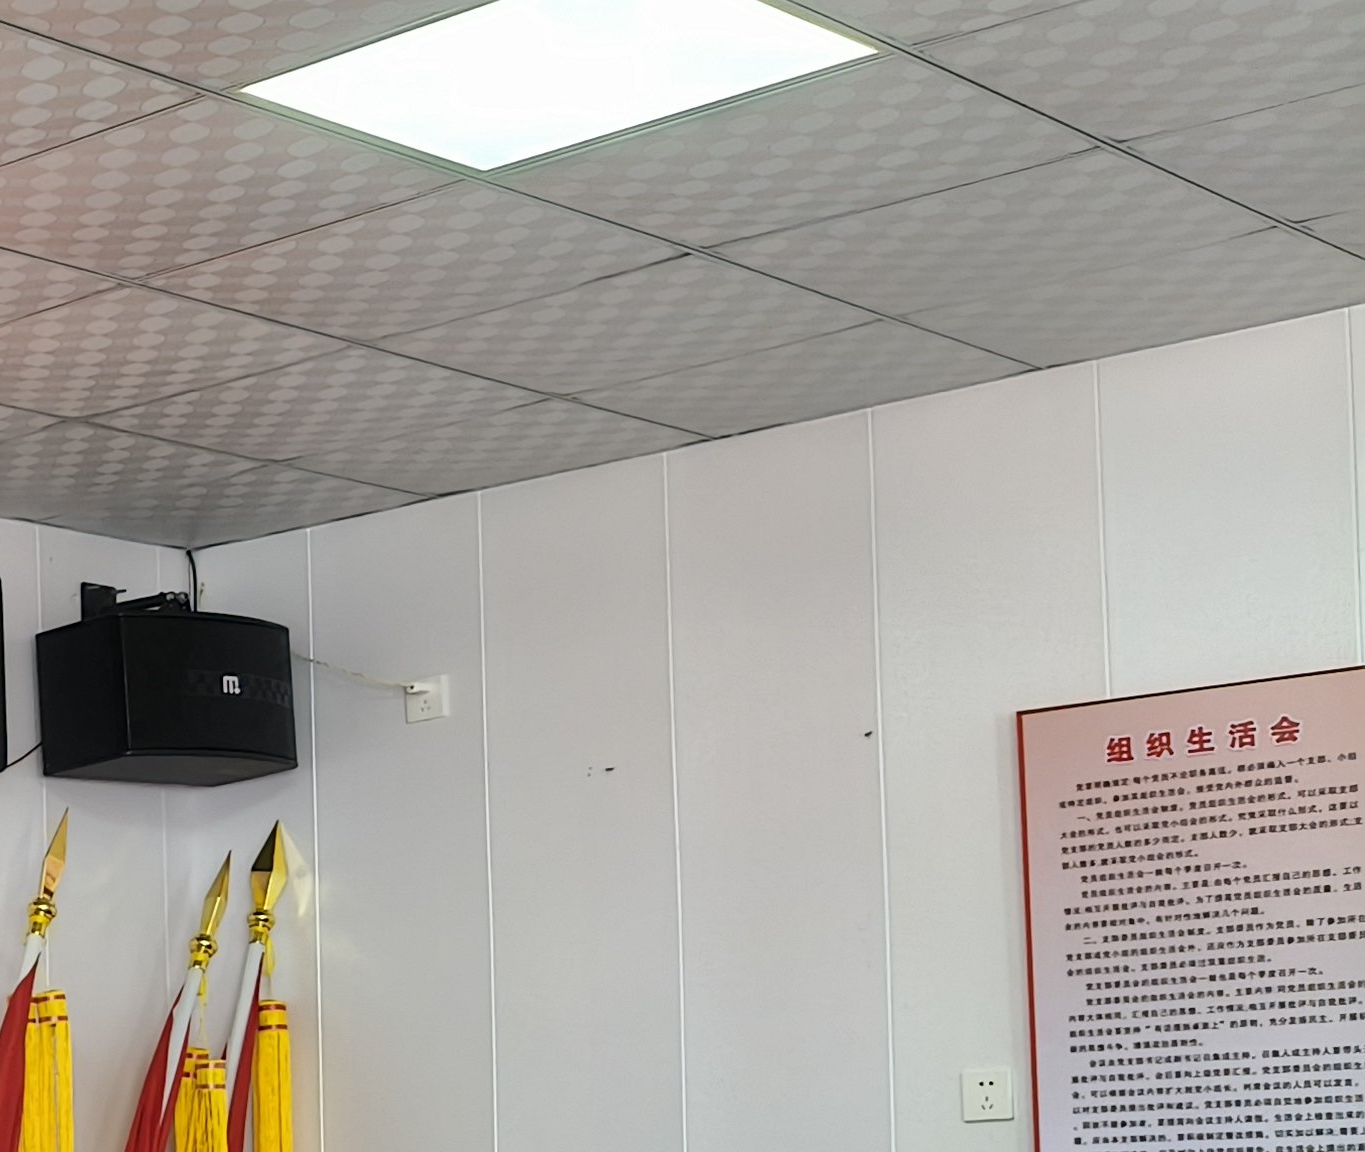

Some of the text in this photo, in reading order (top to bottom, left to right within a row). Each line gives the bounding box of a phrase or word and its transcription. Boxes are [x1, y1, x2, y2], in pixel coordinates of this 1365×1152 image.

[1106, 716, 1301, 763] 组织生活会
